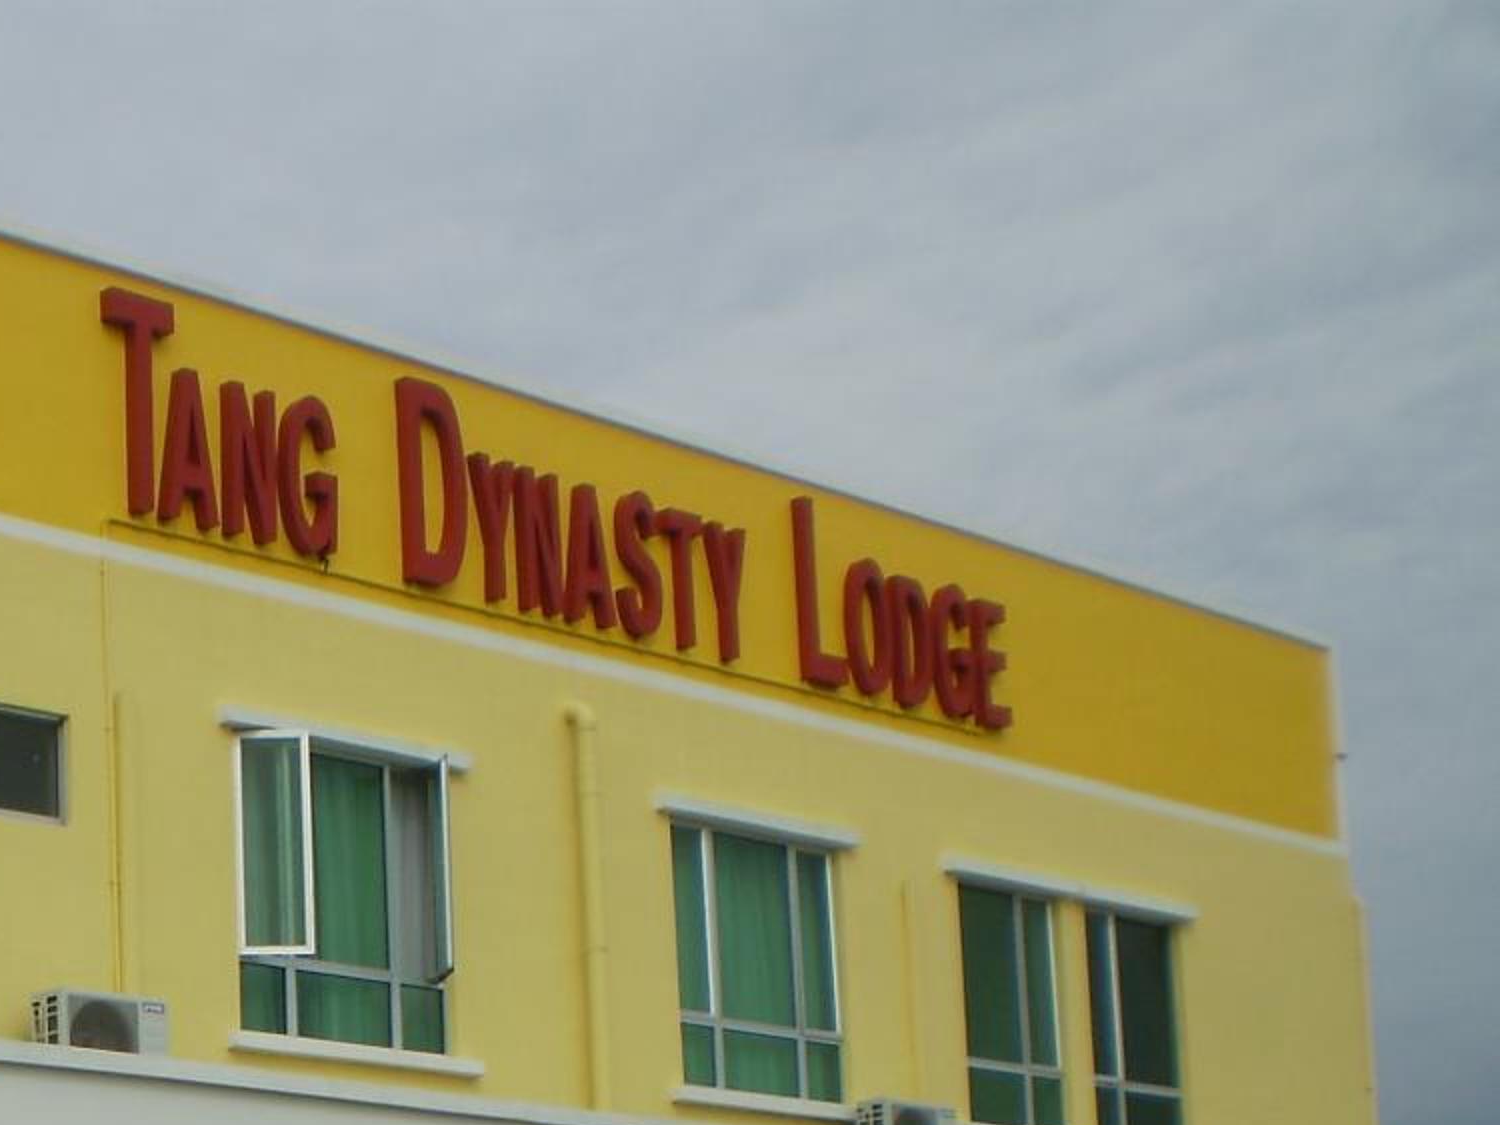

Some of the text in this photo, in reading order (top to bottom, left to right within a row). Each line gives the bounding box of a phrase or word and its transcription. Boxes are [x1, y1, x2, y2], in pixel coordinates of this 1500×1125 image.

[99, 285, 1013, 732] TANG DYNASTY LODGE
